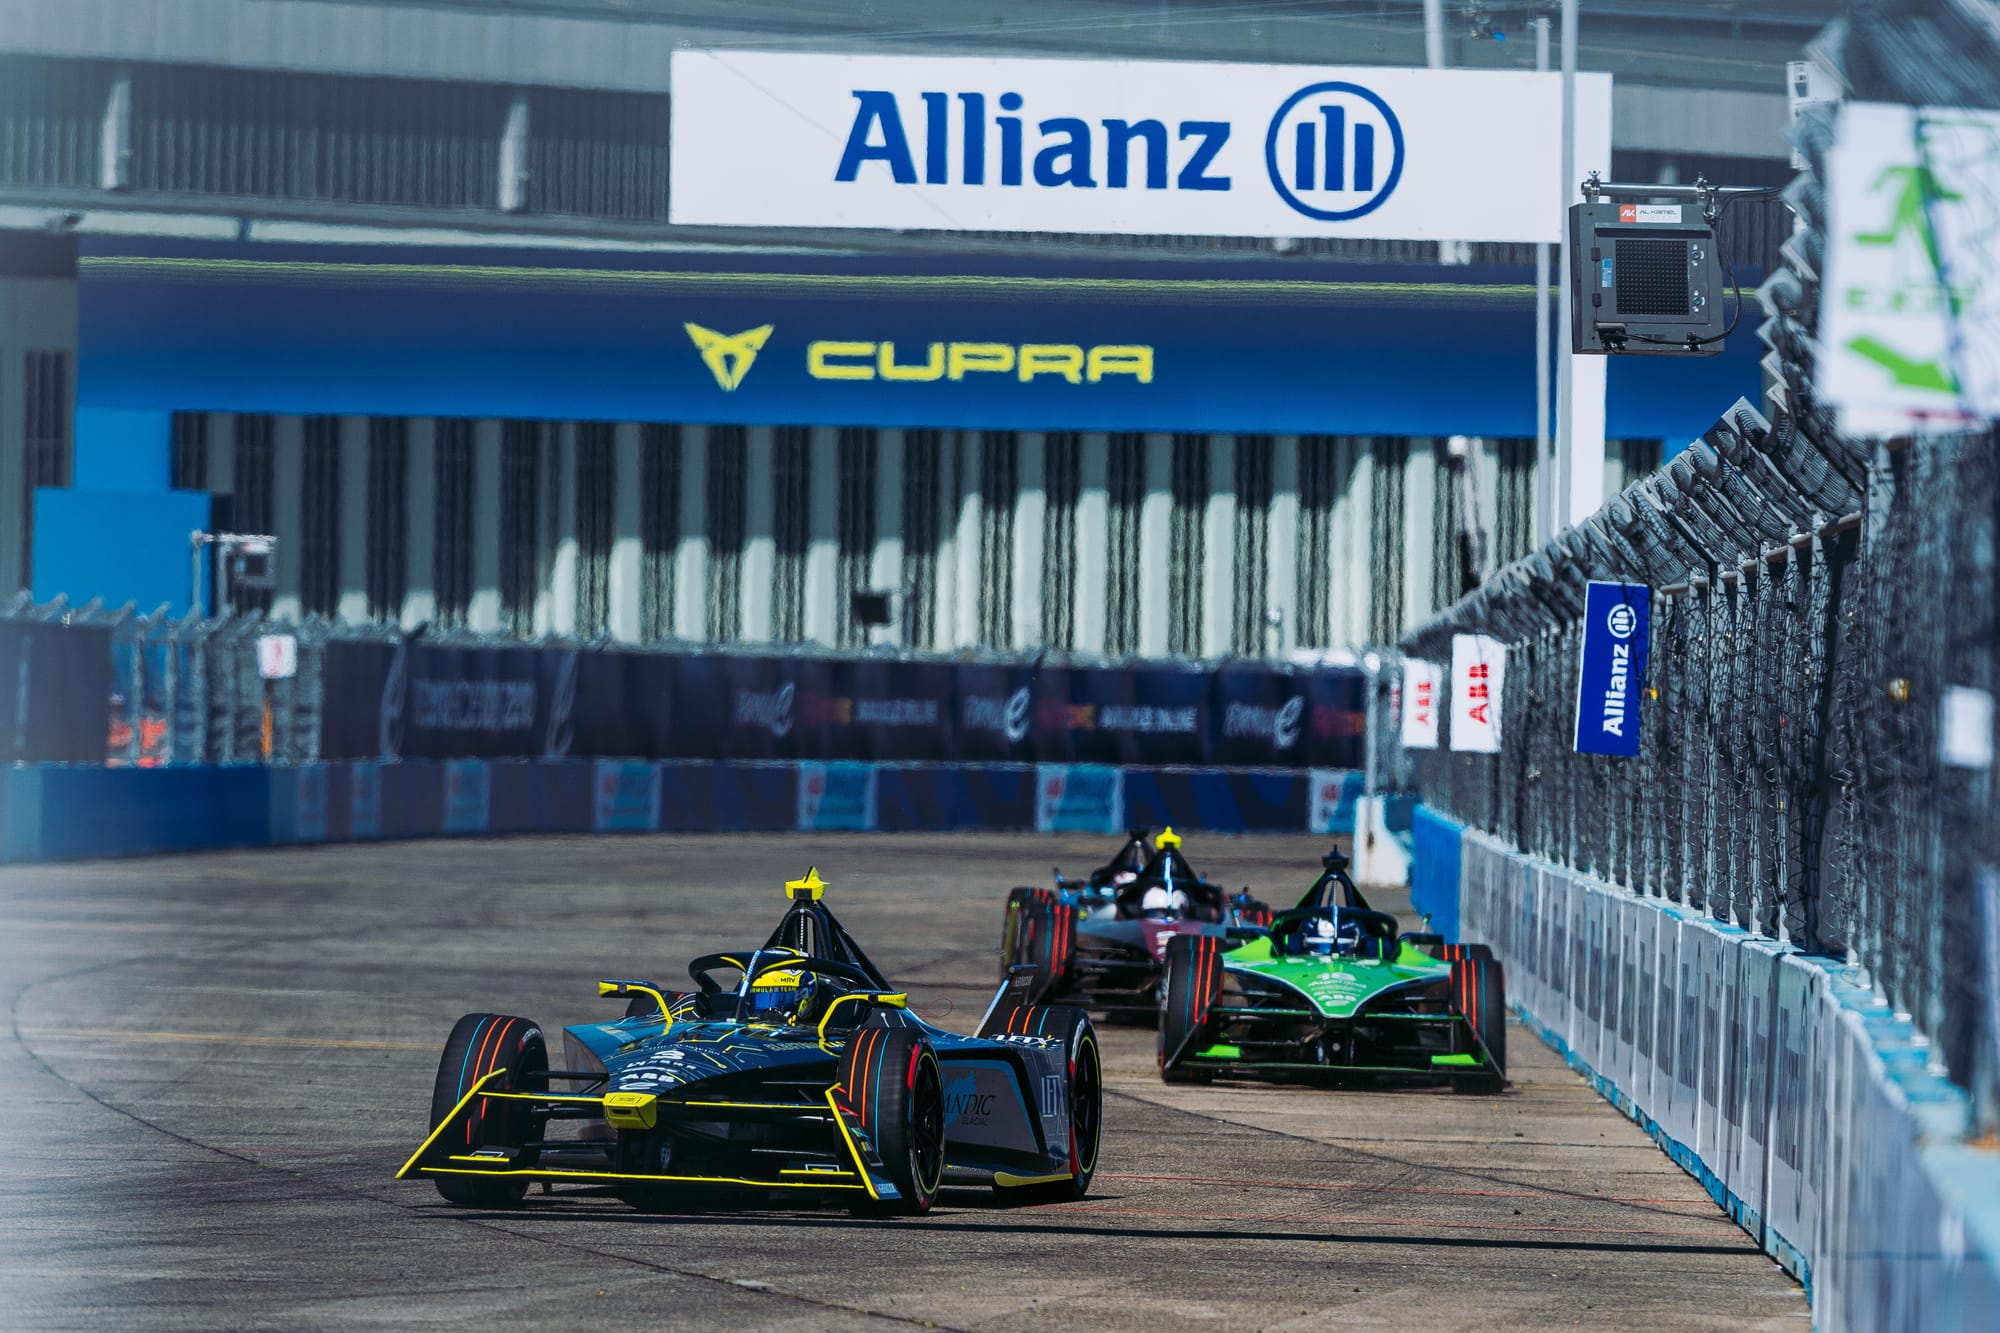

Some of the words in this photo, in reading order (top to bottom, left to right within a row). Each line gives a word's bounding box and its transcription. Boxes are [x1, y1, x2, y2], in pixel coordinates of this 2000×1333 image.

[835, 89, 1232, 191] Allianz
[807, 340, 1155, 385] CUPRA
[1468, 663, 1489, 725] ABB
[1602, 643, 1630, 737] Allianz
[619, 1072, 675, 1083] ABB
[943, 1095, 996, 1116] ANDIC
